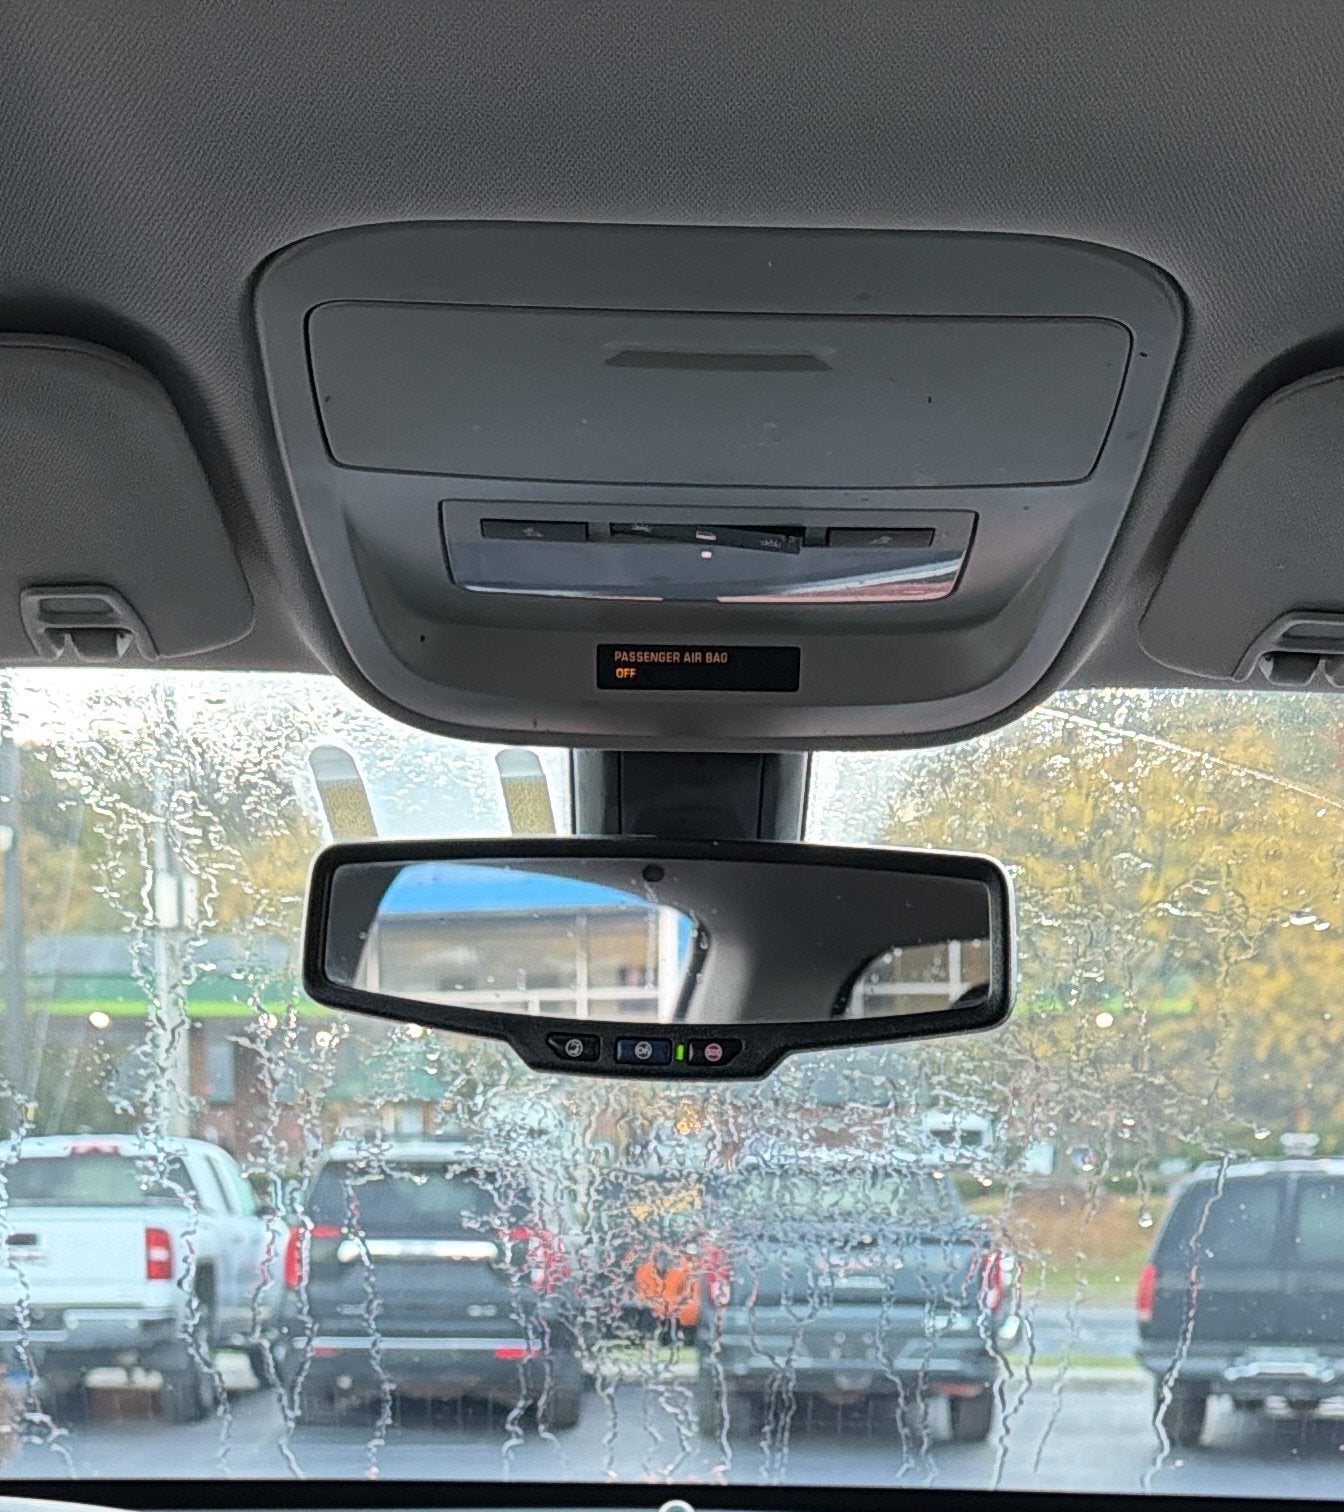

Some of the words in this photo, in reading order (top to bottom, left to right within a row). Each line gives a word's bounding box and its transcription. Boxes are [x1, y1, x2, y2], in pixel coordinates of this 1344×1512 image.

[614, 650, 681, 663] PASSENGER
[684, 651, 702, 663] AIR
[705, 651, 728, 664] BAG
[615, 667, 637, 679] OFF
